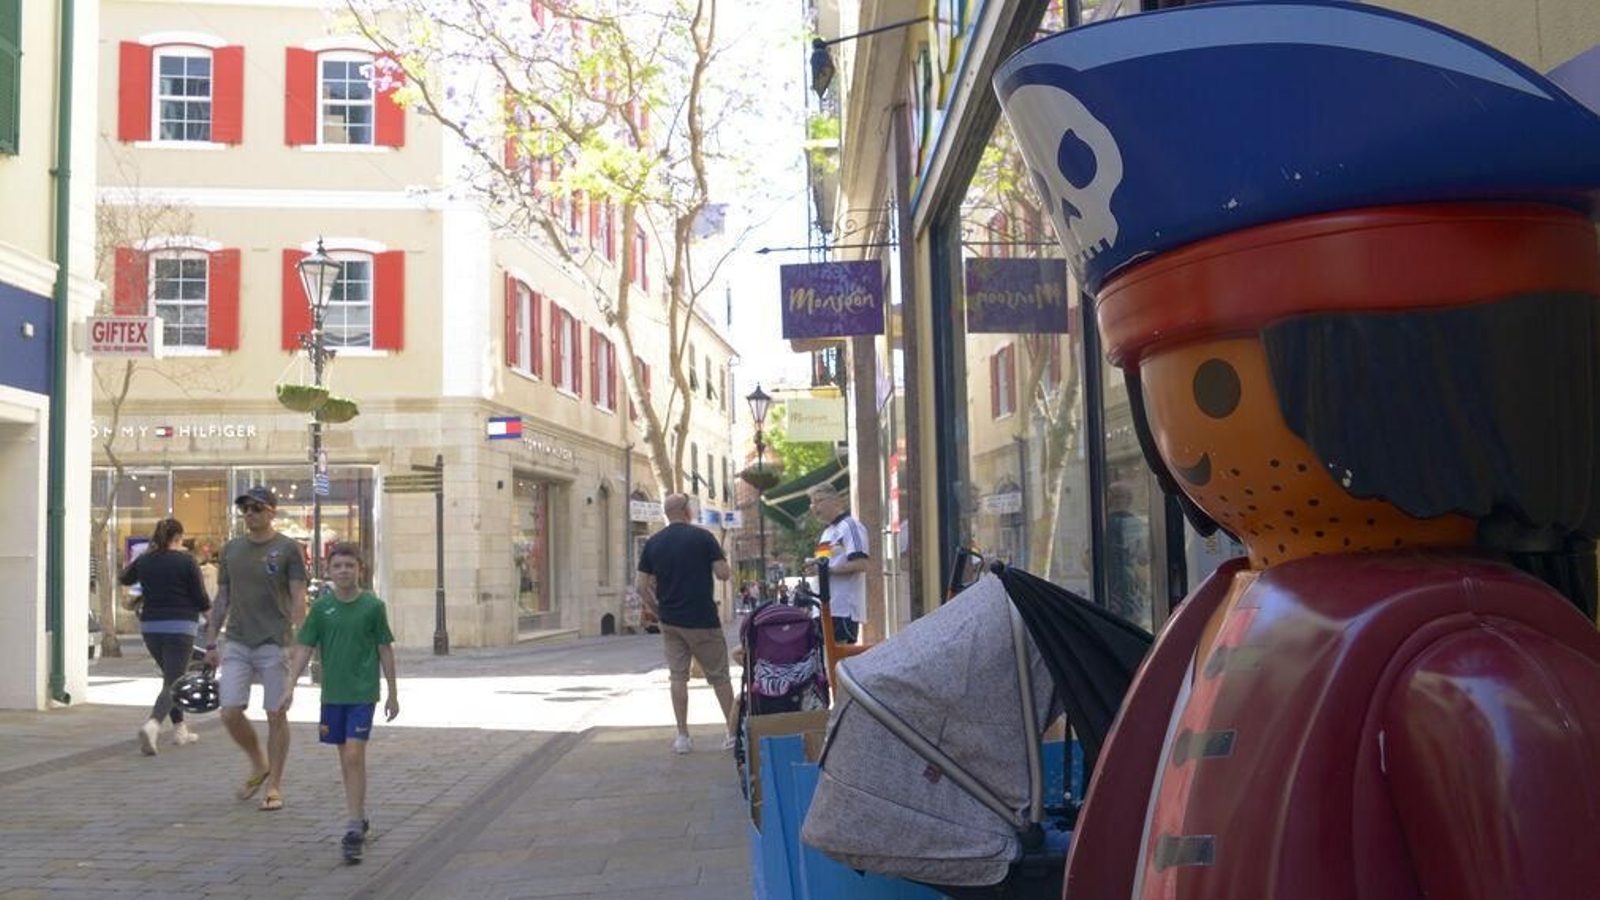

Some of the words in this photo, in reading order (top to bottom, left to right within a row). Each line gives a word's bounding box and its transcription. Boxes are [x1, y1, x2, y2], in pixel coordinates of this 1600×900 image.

[789, 288, 875, 315] Monsoon
[92, 321, 148, 343] GIFTEX
[90, 424, 149, 438] OMMY
[179, 424, 257, 438] HILFIGER
